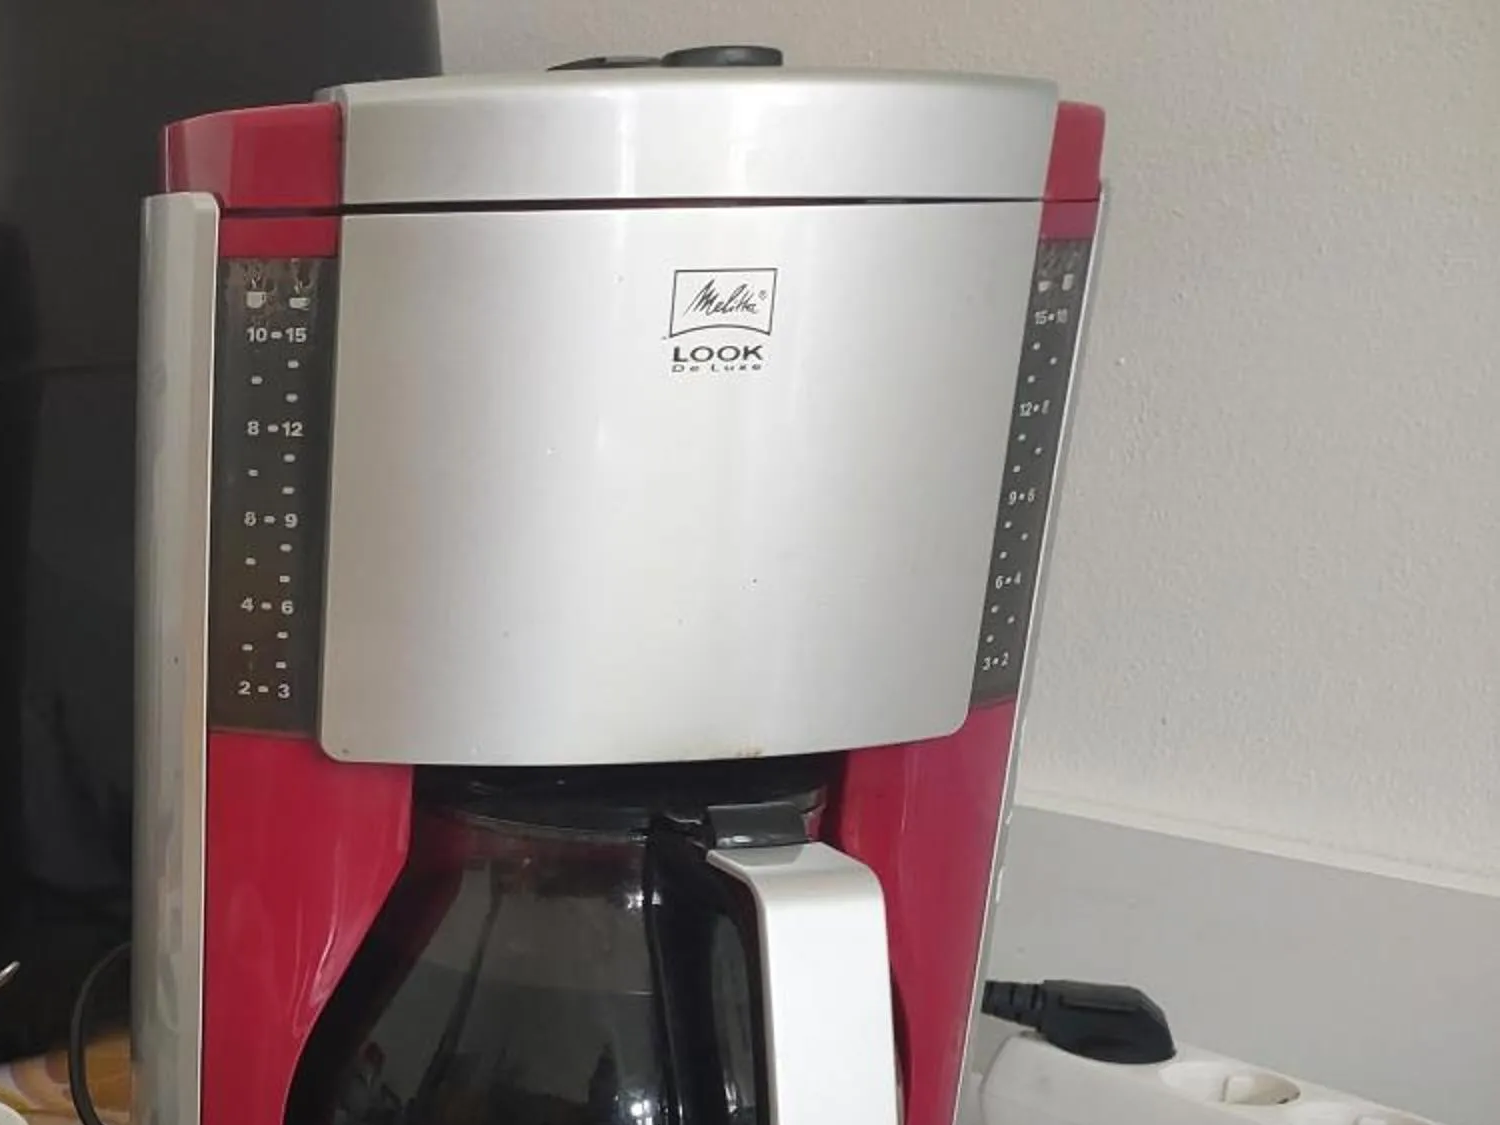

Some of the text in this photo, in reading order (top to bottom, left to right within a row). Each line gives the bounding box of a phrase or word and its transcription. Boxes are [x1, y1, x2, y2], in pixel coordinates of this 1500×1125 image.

[246, 327, 307, 342] 10 15
[672, 345, 763, 362] LOOK
[247, 421, 304, 437] 8 12
[284, 513, 298, 528] 9
[240, 597, 294, 615] 4 6
[238, 680, 290, 698] 2 3
